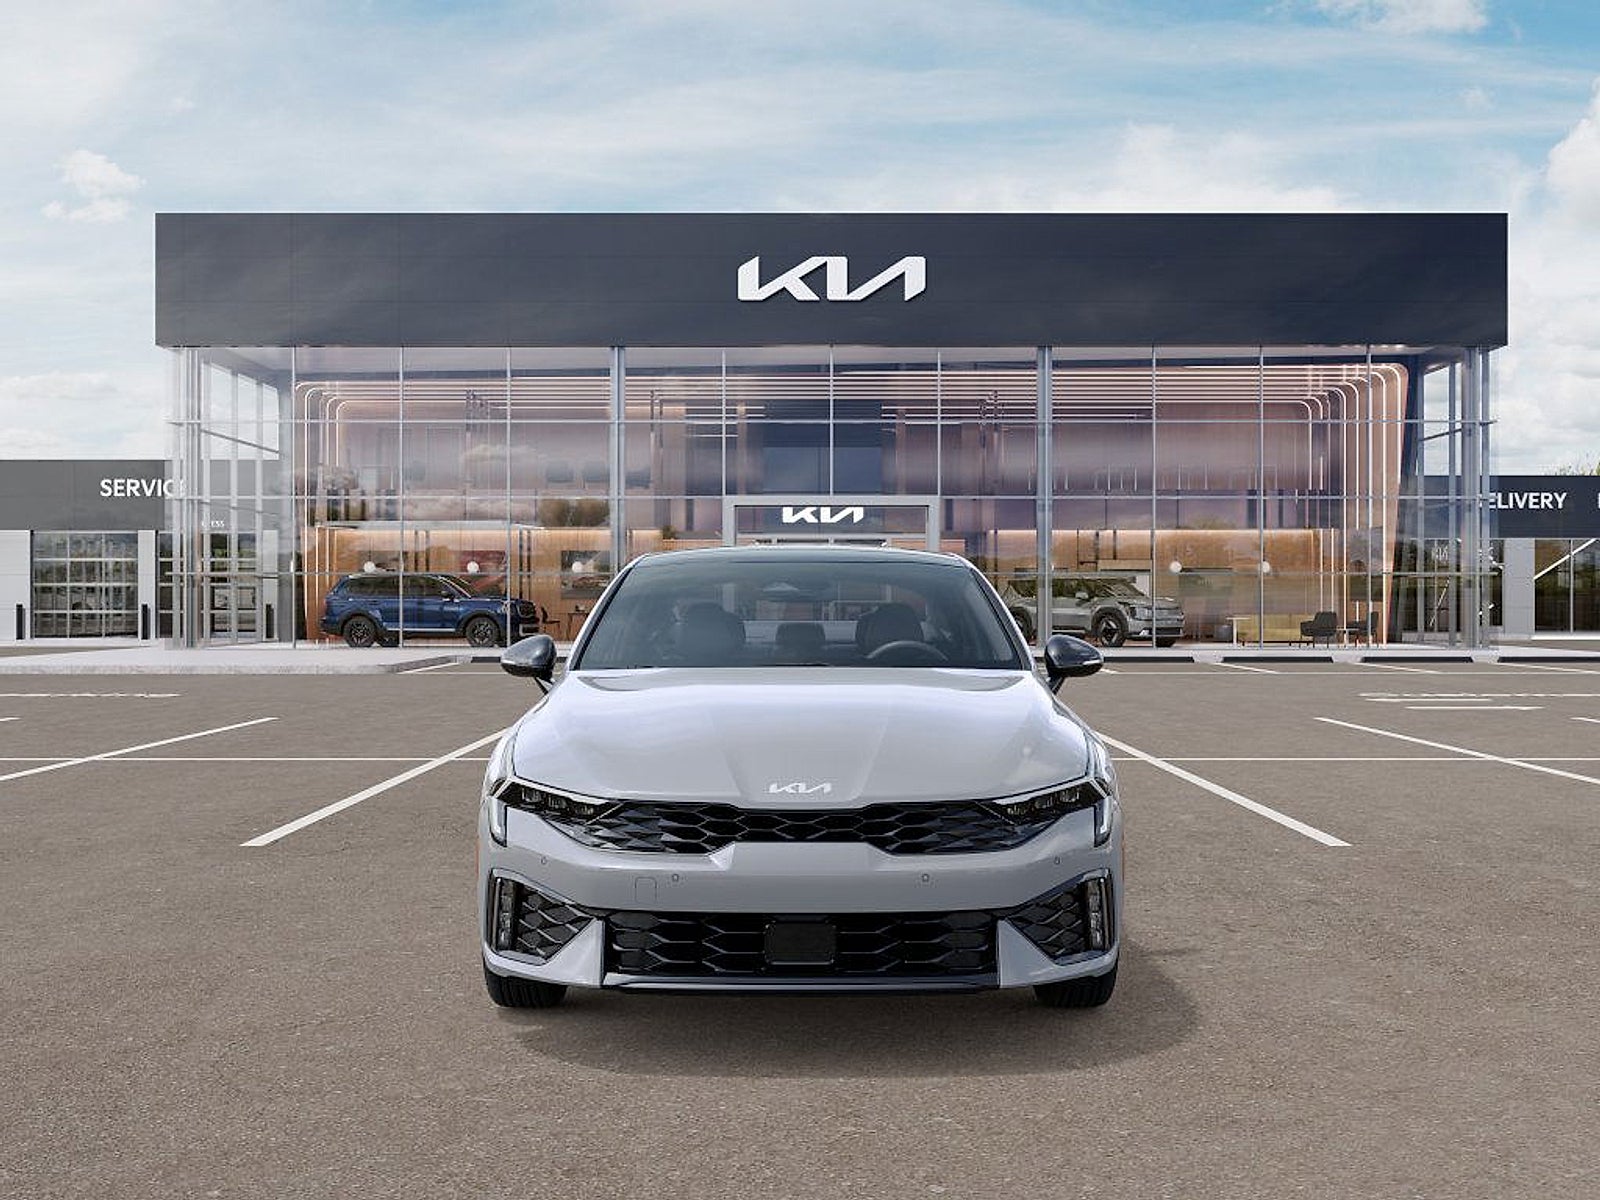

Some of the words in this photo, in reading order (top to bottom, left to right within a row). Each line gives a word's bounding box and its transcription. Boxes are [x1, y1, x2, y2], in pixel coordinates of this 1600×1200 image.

[738, 256, 926, 301] KIA
[100, 479, 187, 498] SERVIC
[1477, 492, 1567, 509] ELIVERY
[782, 506, 864, 524] KIA
[769, 782, 832, 794] KIA
